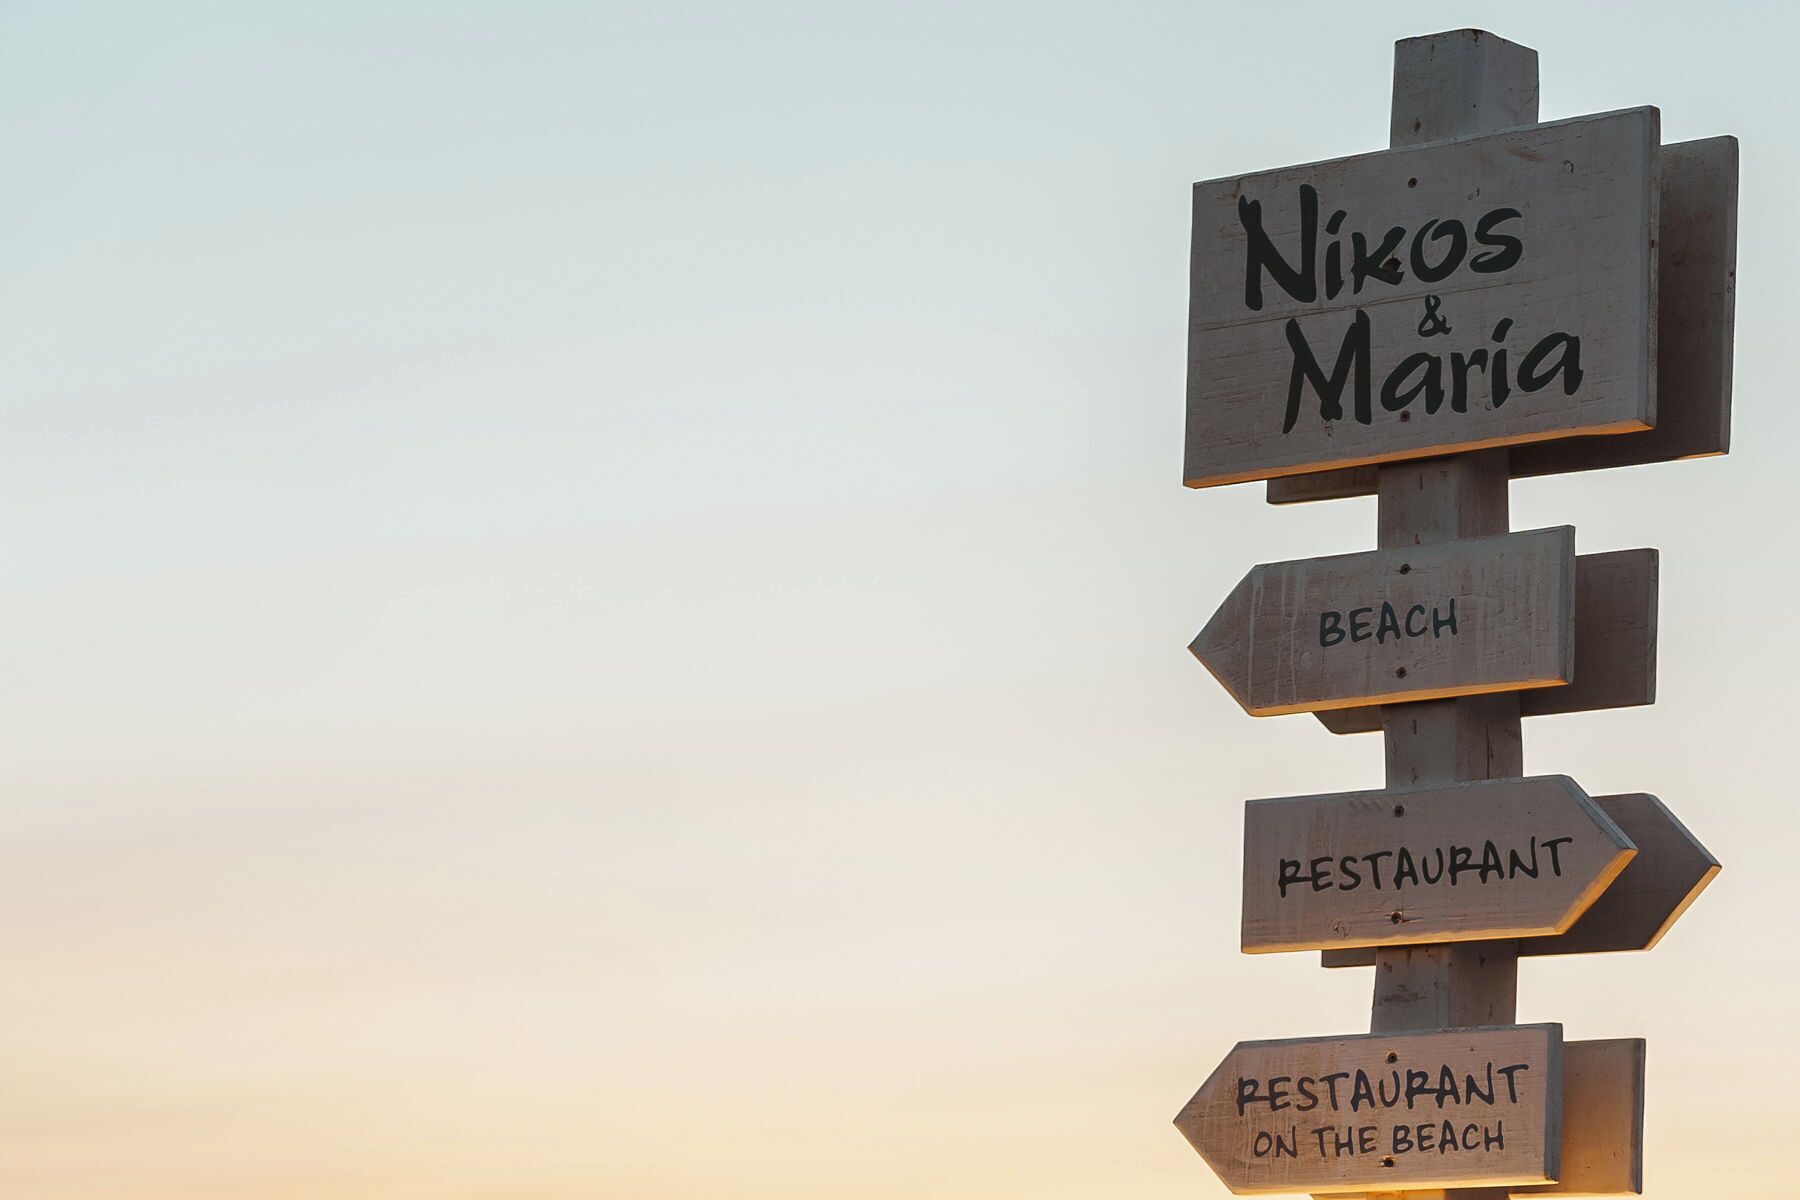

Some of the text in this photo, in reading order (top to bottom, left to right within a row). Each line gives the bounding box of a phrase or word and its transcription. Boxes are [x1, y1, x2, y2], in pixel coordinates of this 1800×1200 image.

[1417, 294, 1452, 338] &
[1318, 598, 1459, 648] BEACH
[1277, 836, 1574, 898] RESTAURANT
[1236, 1062, 1529, 1117] RESTAURANT
[1252, 1119, 1506, 1159] ON THE BEACH
